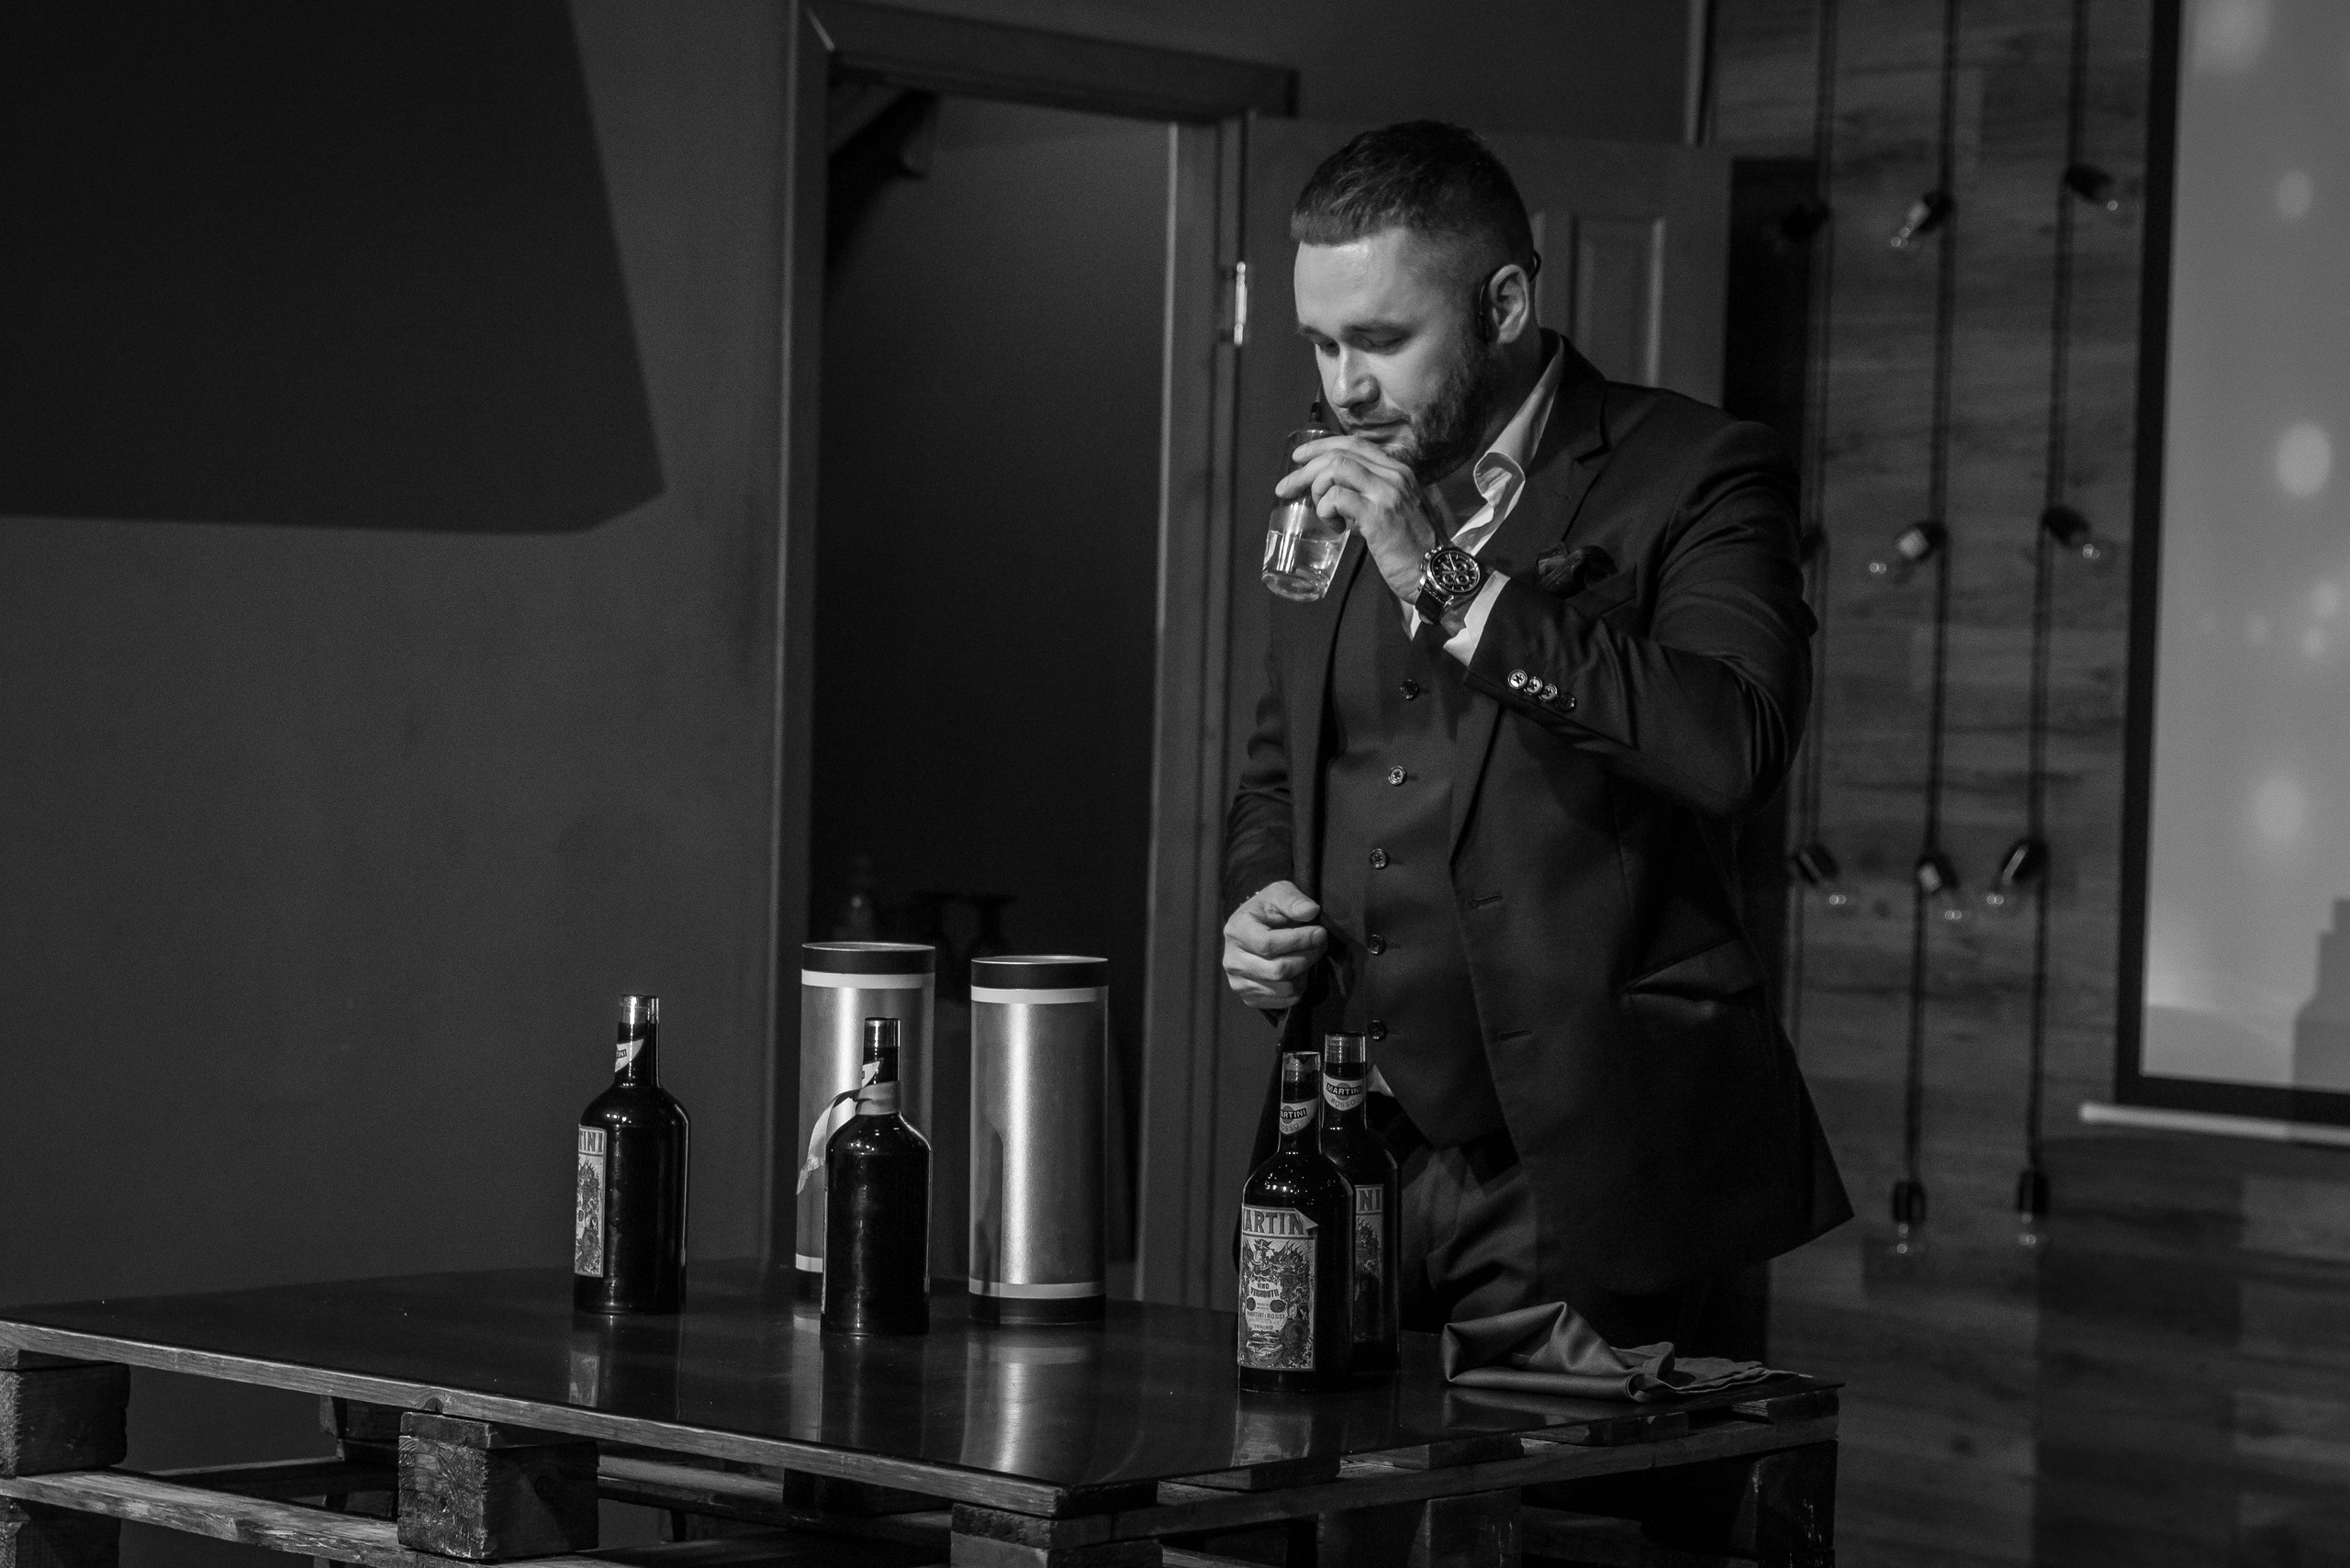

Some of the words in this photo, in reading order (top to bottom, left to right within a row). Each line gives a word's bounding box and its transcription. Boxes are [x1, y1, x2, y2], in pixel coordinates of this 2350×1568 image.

[1327, 1083, 1361, 1095] MARTINI
[1331, 1098, 1355, 1108] ROSSO
[1281, 1108, 1306, 1119] ARTINI
[1281, 1123, 1299, 1131] OSSO
[1243, 1208, 1313, 1236] ARTIN
